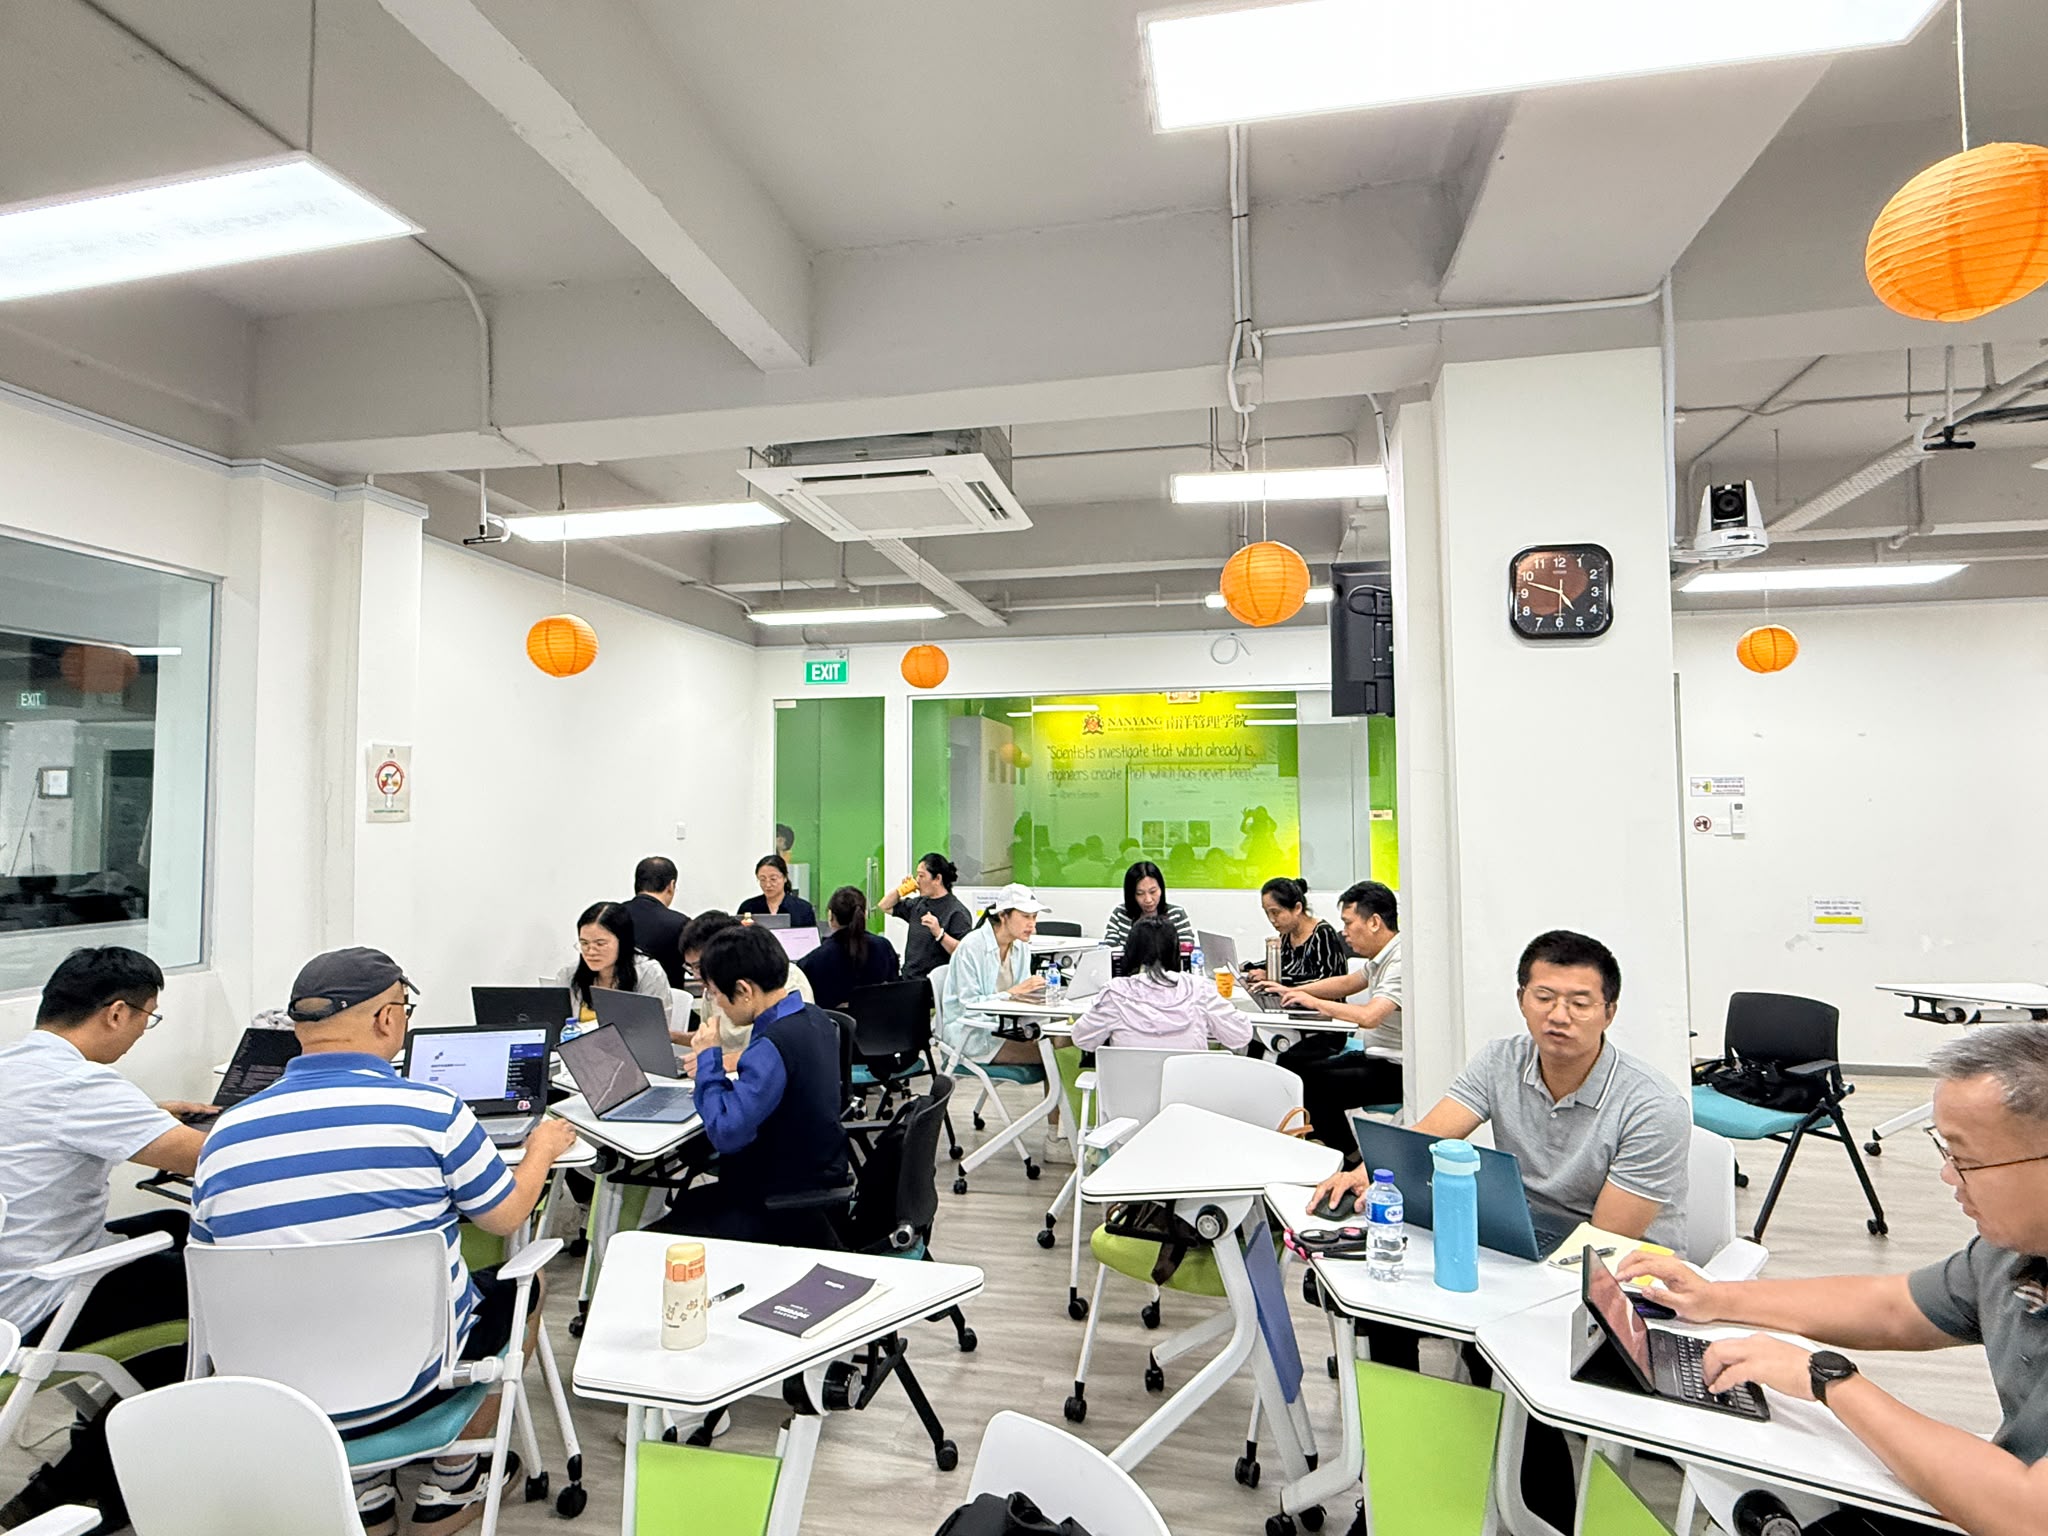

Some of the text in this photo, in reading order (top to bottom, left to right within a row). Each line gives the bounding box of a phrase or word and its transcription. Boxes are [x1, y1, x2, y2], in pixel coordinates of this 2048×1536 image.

[1534, 559, 1545, 569] 11
[1553, 557, 1566, 568] 12
[1576, 558, 1582, 567] 1
[1521, 571, 1534, 581] 10
[1589, 570, 1598, 580] 2
[1520, 589, 1528, 599] 9
[1591, 587, 1599, 597] 3
[1522, 606, 1530, 616] 8
[1589, 604, 1597, 614] 4
[1535, 617, 1543, 628] 7
[1555, 617, 1563, 627] 6
[1576, 616, 1583, 626] 5
[811, 663, 840, 680] EXIT
[21, 692, 41, 706] EXIT
[1107, 717, 1162, 727] NANYANG
[1098, 743, 1149, 761] investigate
[1152, 743, 1172, 758] that
[1176, 742, 1203, 758] which
[1205, 742, 1241, 763] already
[1091, 767, 1122, 781] create
